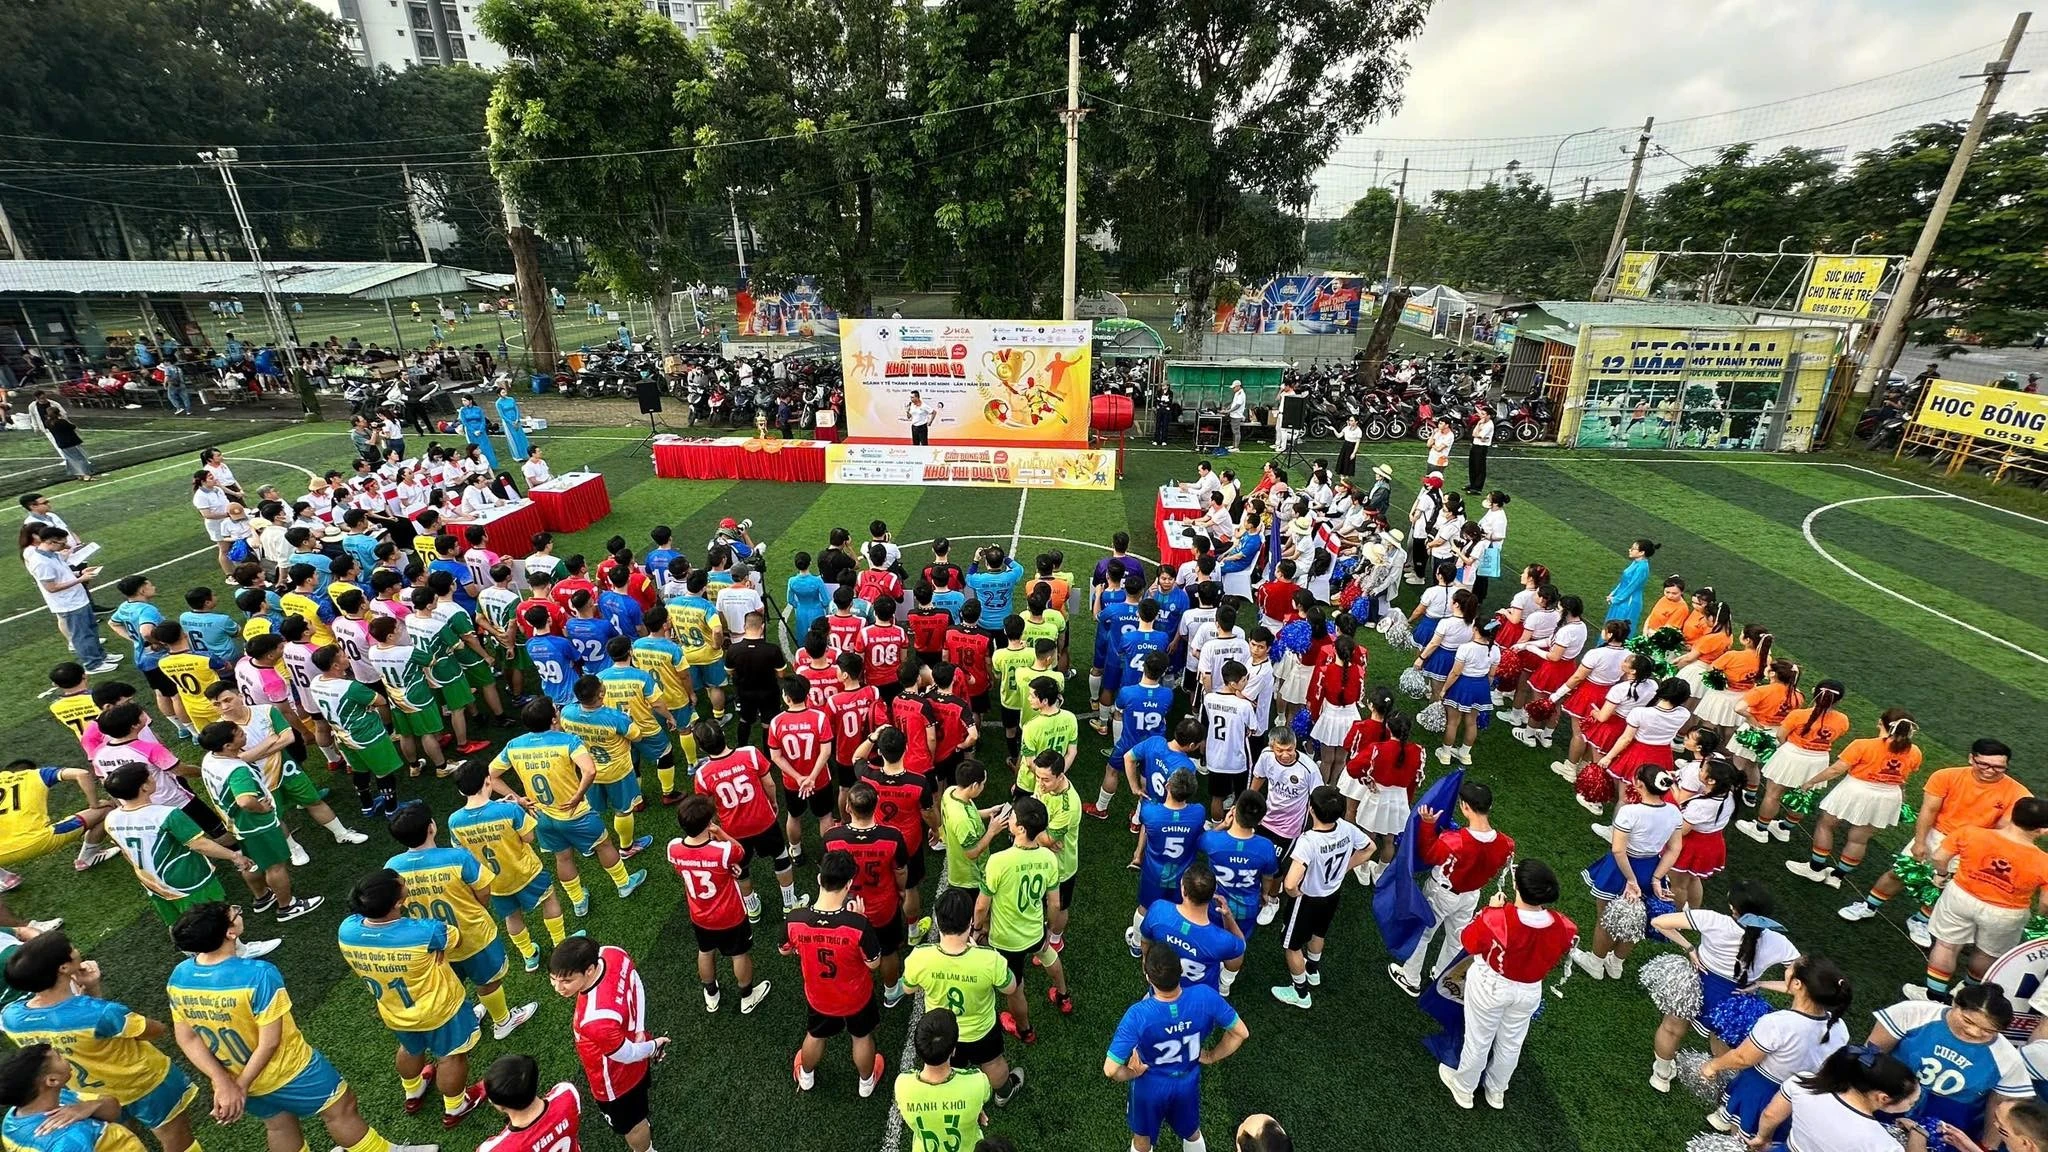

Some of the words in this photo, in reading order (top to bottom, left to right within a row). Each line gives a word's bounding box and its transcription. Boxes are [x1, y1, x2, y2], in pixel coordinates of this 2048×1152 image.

[1808, 286, 1825, 298] CHO
[1829, 305, 1841, 313] 407
[1842, 306, 1856, 314] 517
[951, 362, 966, 378] 12
[1600, 356, 1626, 375] 12
[1930, 395, 1975, 417] HỌC
[1980, 401, 2048, 432] BỔNG
[1984, 428, 2036, 444] 0898
[952, 465, 969, 481] THI
[995, 467, 1011, 483] 12
[983, 589, 1009, 608] 23
[572, 639, 605, 662] 22
[871, 644, 899, 667] 08
[171, 672, 202, 695] 10
[287, 664, 311, 688] 15
[534, 660, 563, 684] 39
[1132, 711, 1162, 731] 19
[1213, 715, 1226, 742] 2
[782, 732, 815, 760] 07
[531, 773, 554, 806] 9
[716, 774, 755, 809] 05
[1151, 771, 1166, 797] 6
[1163, 837, 1185, 859] 5
[1229, 855, 1250, 865] HUY
[1214, 865, 1258, 888] 23
[1324, 850, 1348, 884] 17
[681, 870, 718, 899] 13
[1166, 933, 1198, 957] KHOA
[817, 948, 838, 979] 5
[1180, 958, 1206, 982] 8
[947, 987, 966, 1017] 8
[1164, 1020, 1193, 1035] VIỆT
[192, 1025, 253, 1067] 20
[1153, 1031, 1201, 1065] 21
[1933, 1044, 1974, 1069] CURBY
[1917, 1057, 1966, 1096] 30
[532, 1129, 554, 1152] Văn
